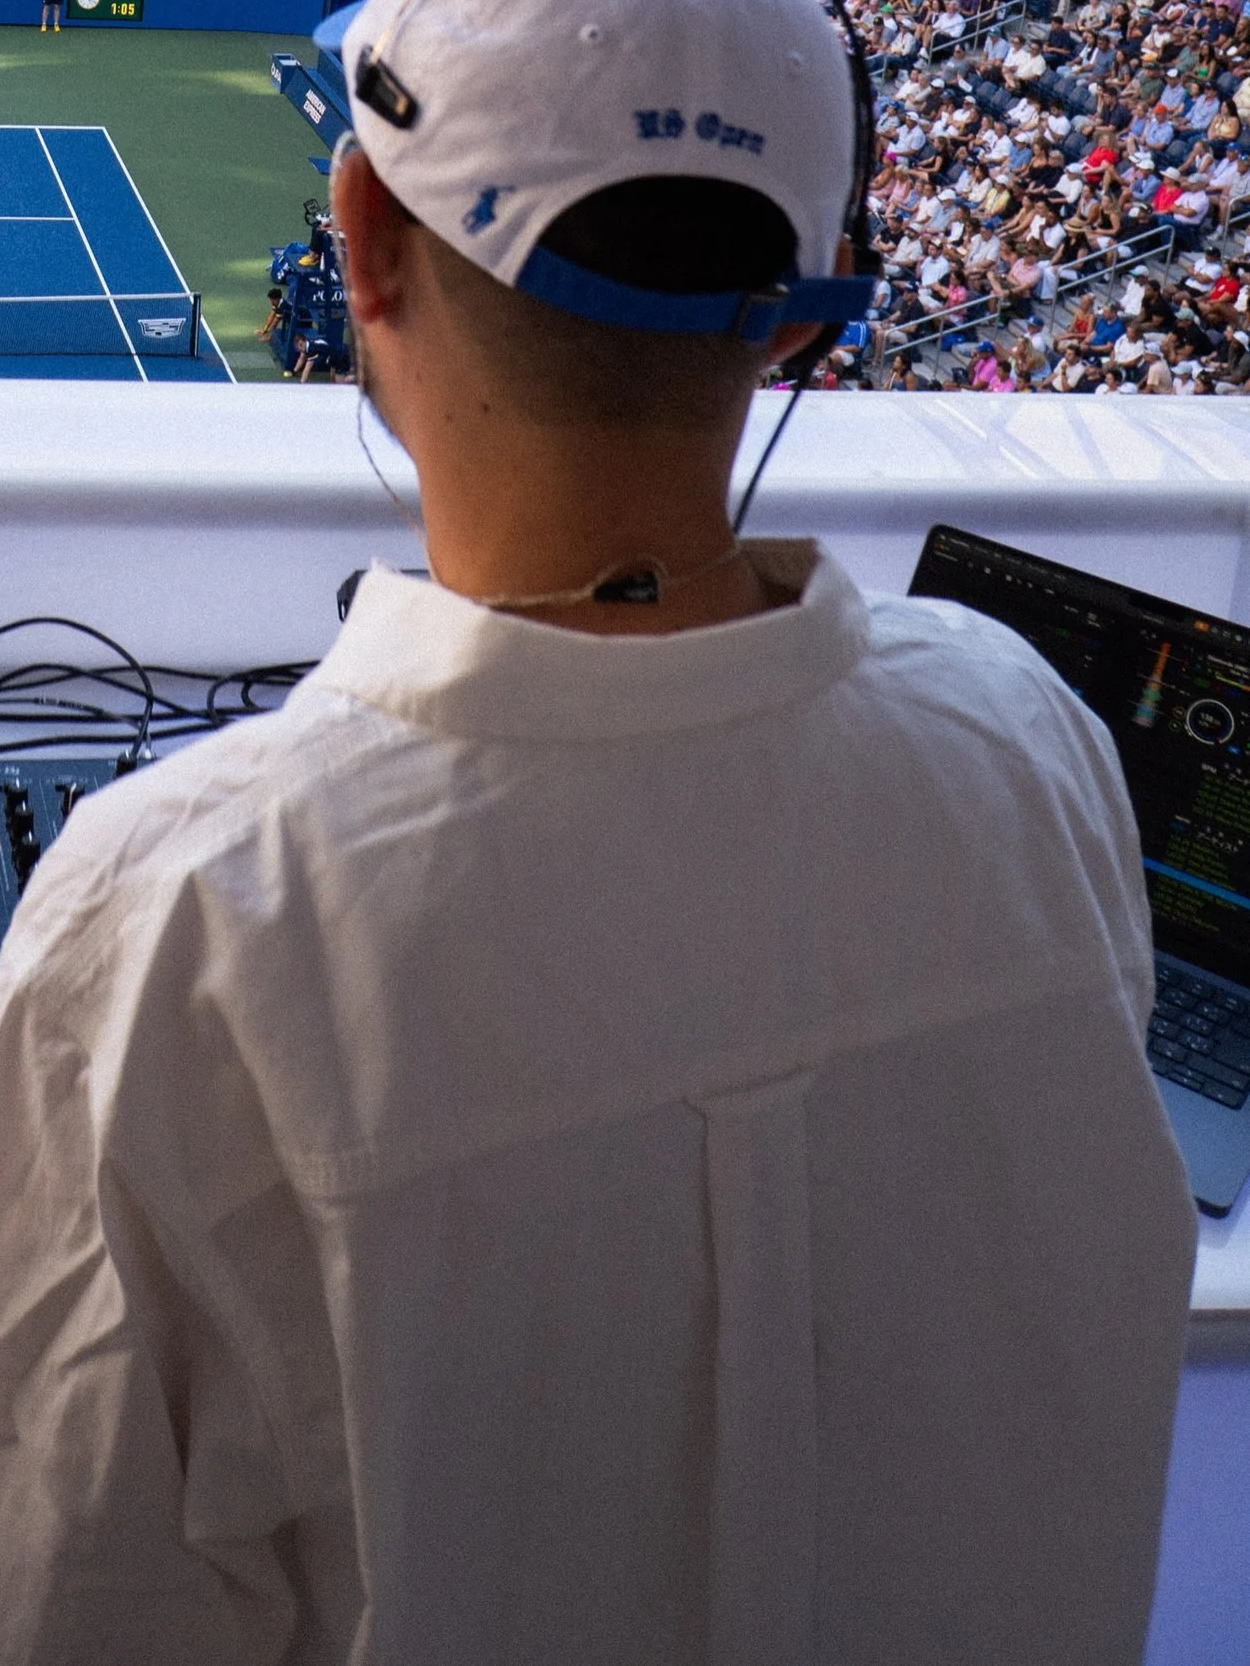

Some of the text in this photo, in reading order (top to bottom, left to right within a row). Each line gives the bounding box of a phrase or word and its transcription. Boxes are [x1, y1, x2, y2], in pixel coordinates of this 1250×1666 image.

[111, 2, 135, 15] 1:05
[634, 107, 766, 156] US Open
